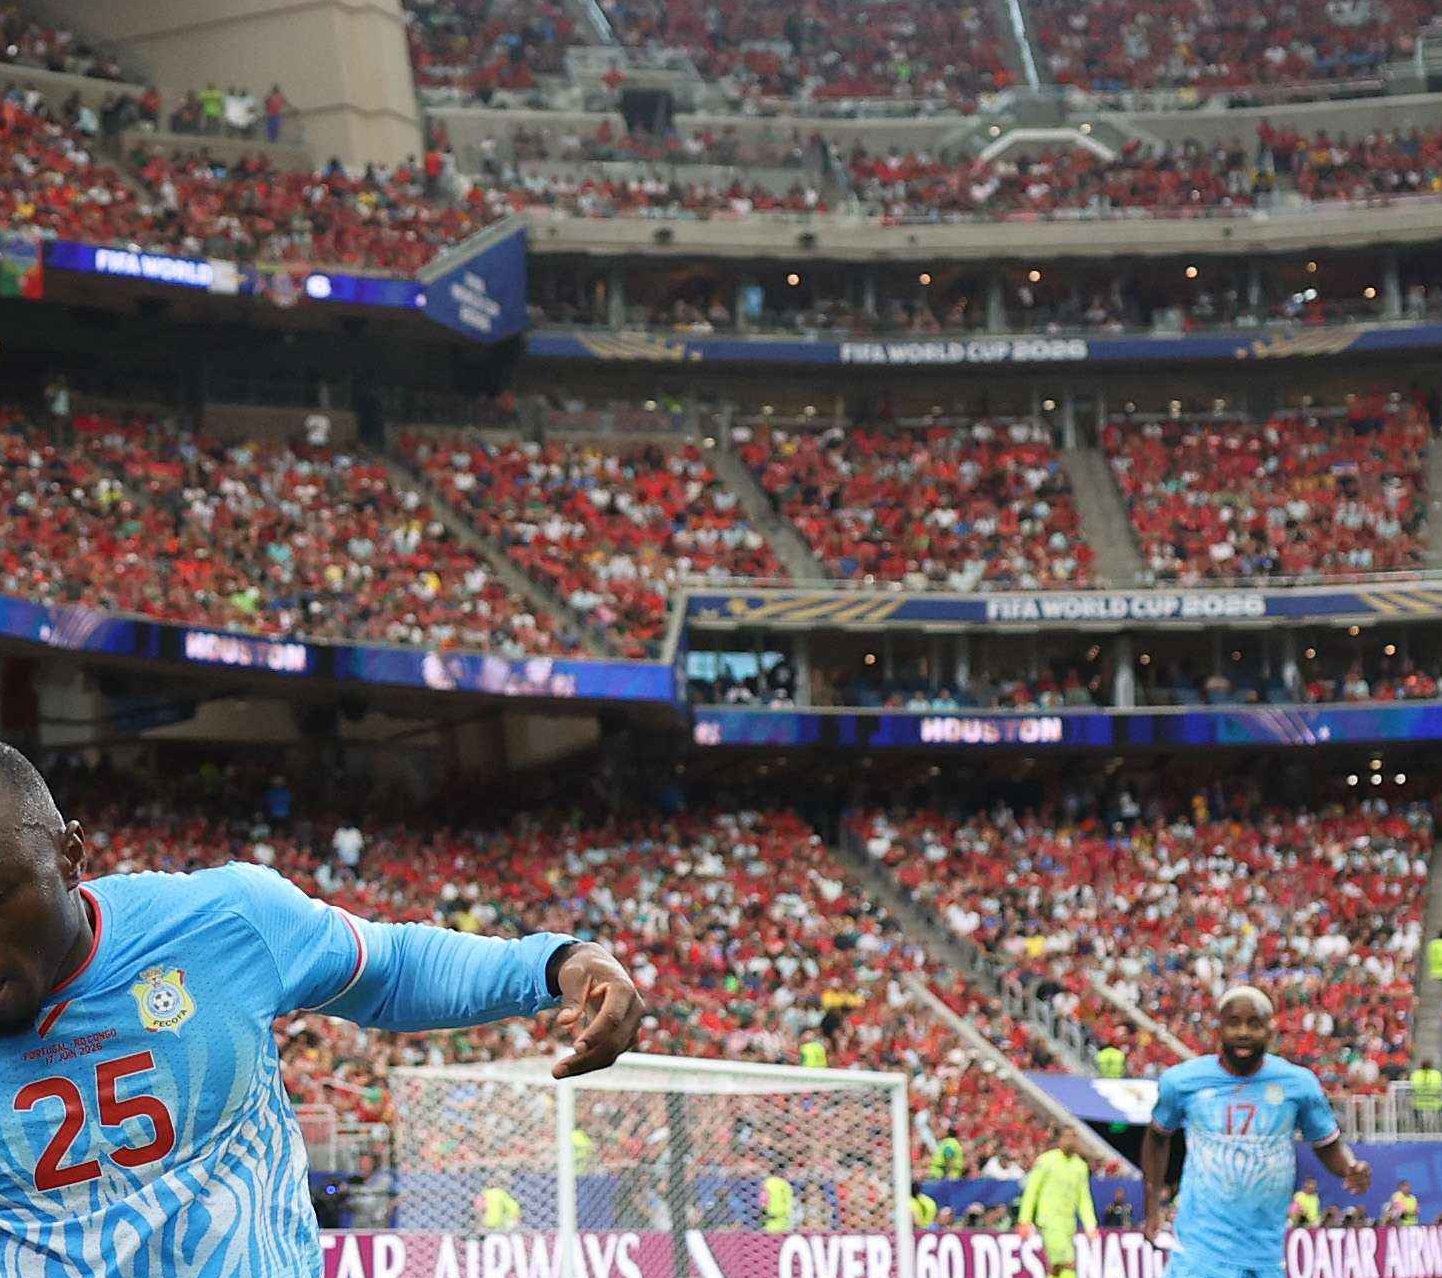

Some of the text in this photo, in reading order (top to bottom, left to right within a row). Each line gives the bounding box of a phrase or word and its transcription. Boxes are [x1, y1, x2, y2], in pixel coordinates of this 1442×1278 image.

[987, 593, 1267, 621] FIFA WORLD CUP 2026
[920, 716, 1063, 744] HOUSTON
[14, 1050, 176, 1193] 25
[1225, 1103, 1257, 1137] 17
